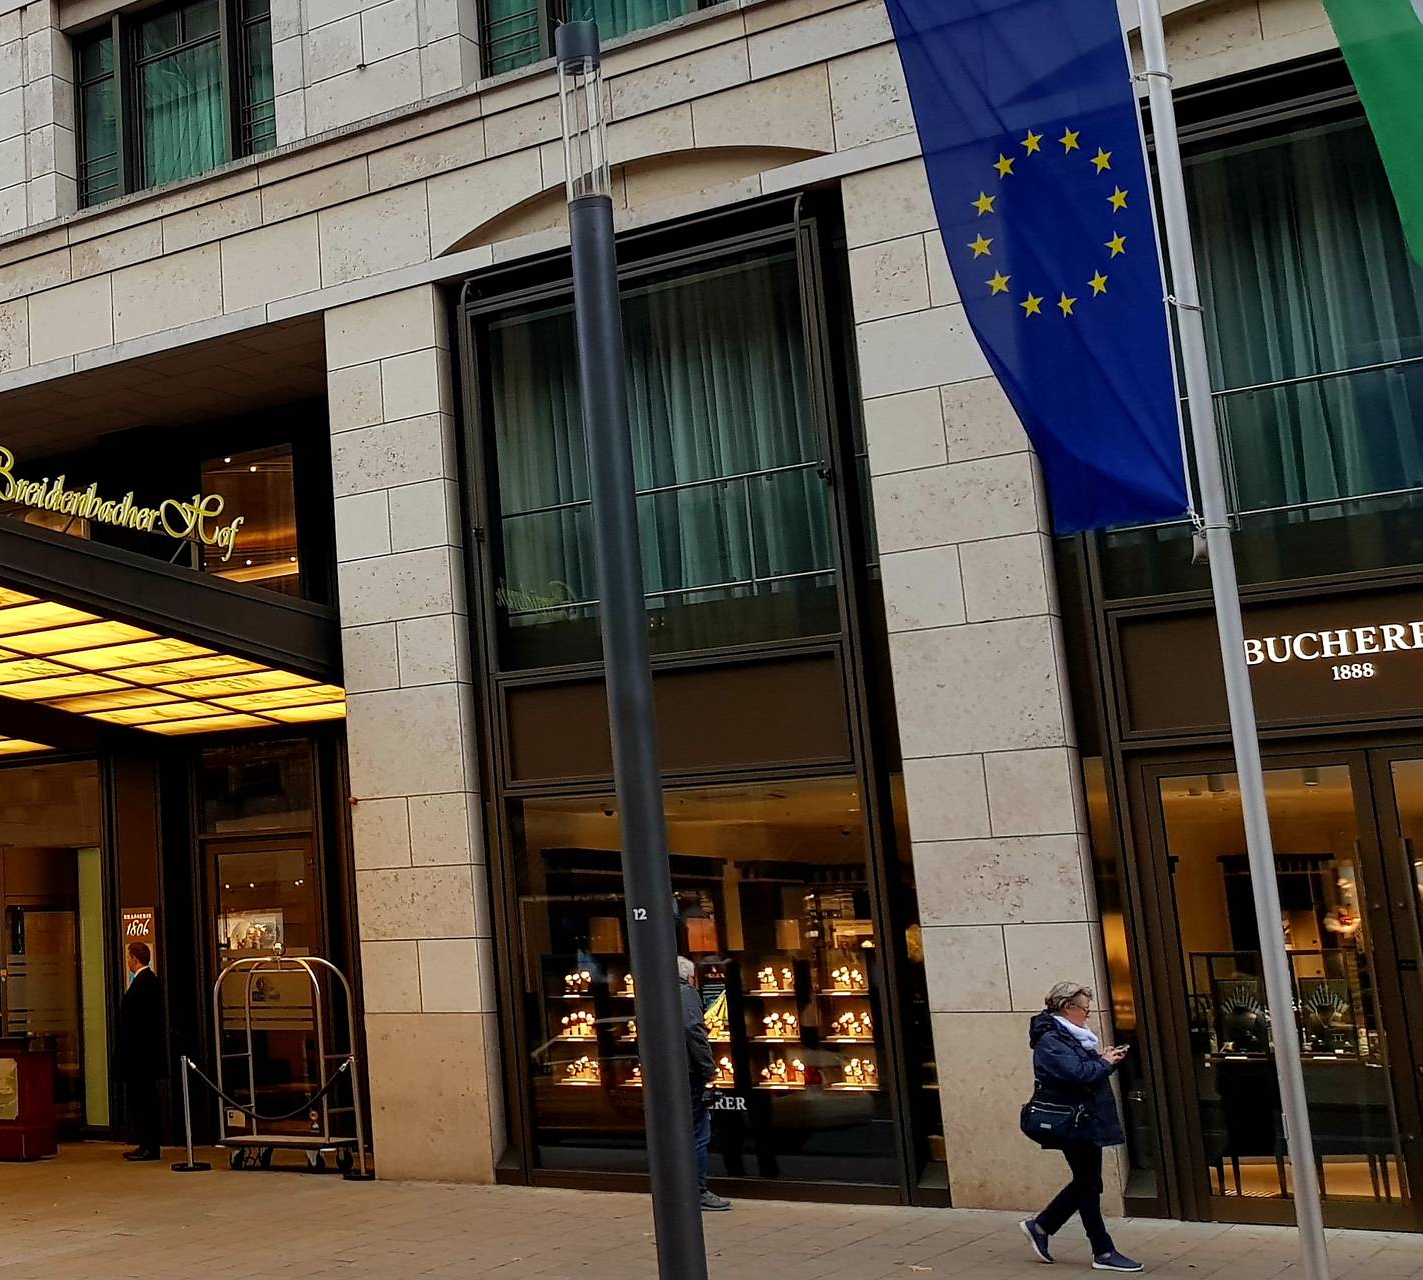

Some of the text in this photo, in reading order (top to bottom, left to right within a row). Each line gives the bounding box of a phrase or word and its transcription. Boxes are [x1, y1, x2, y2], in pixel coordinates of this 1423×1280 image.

[160, 494, 244, 561] Hof
[1332, 662, 1374, 681] 1888
[633, 908, 647, 920] 12
[126, 919, 150, 936] 1806
